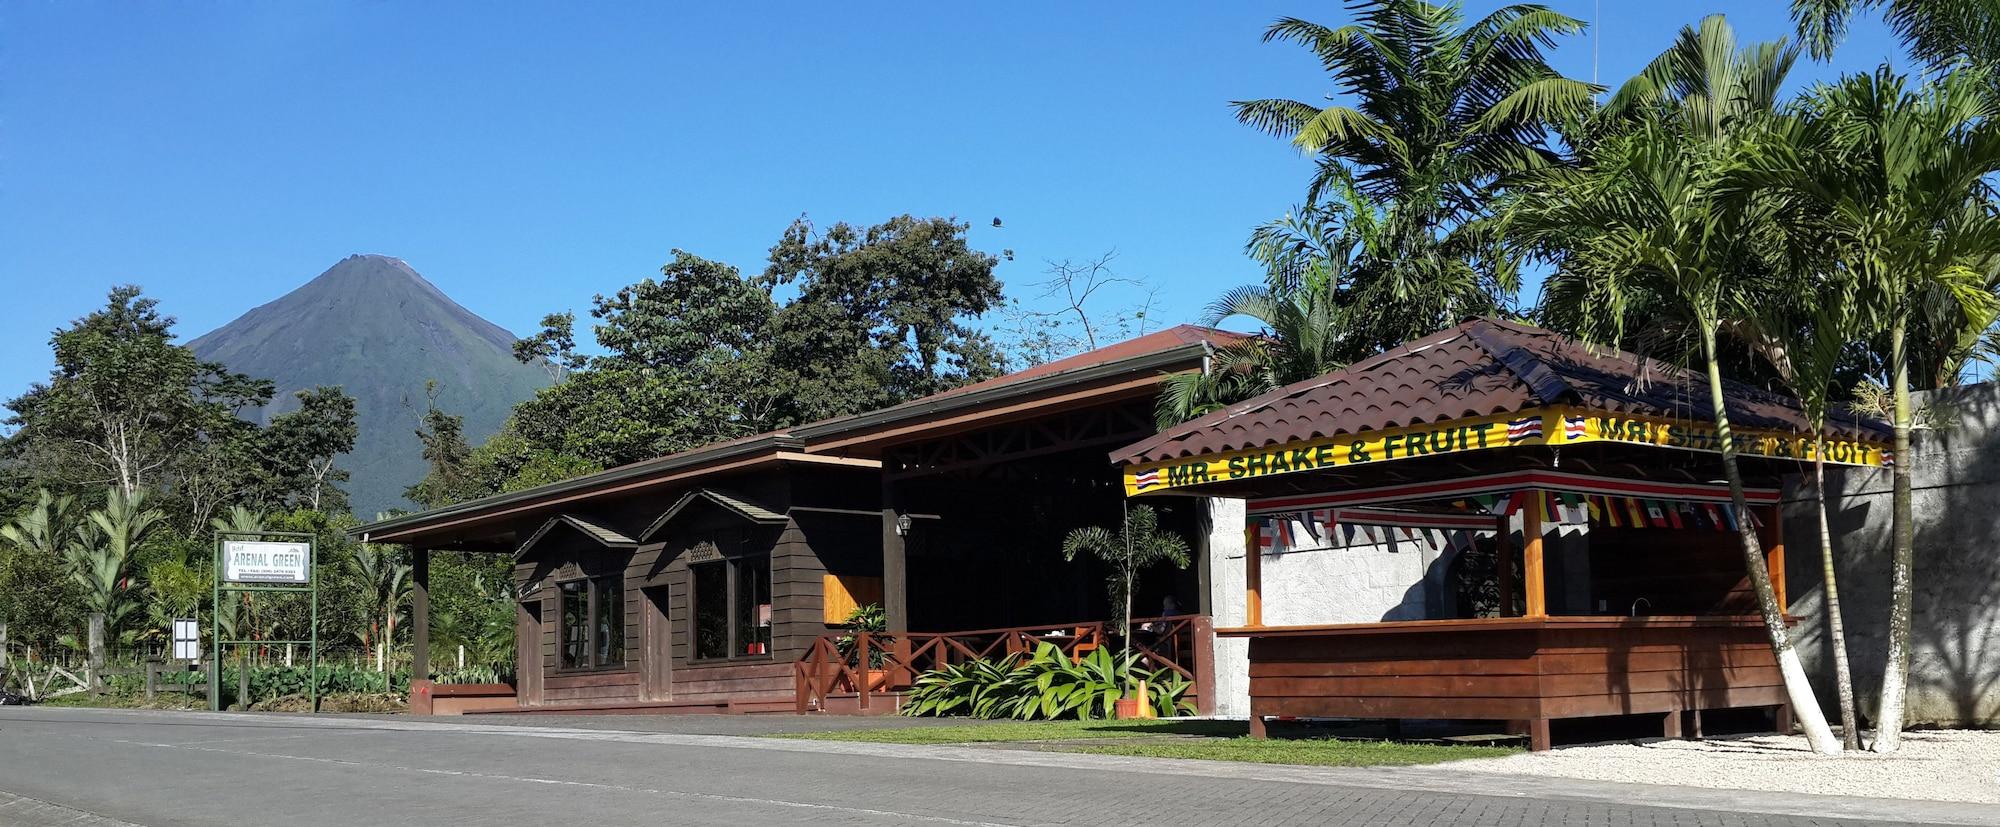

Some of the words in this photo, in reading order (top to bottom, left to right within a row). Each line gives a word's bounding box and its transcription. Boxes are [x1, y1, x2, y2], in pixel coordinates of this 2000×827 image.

[1168, 462, 1218, 487] MR.
[1228, 443, 1335, 479] SHAKE
[1348, 440, 1371, 463] &
[1384, 423, 1493, 460] FRUIT
[233, 553, 268, 567] ARENAL
[272, 553, 301, 567] GREEN
